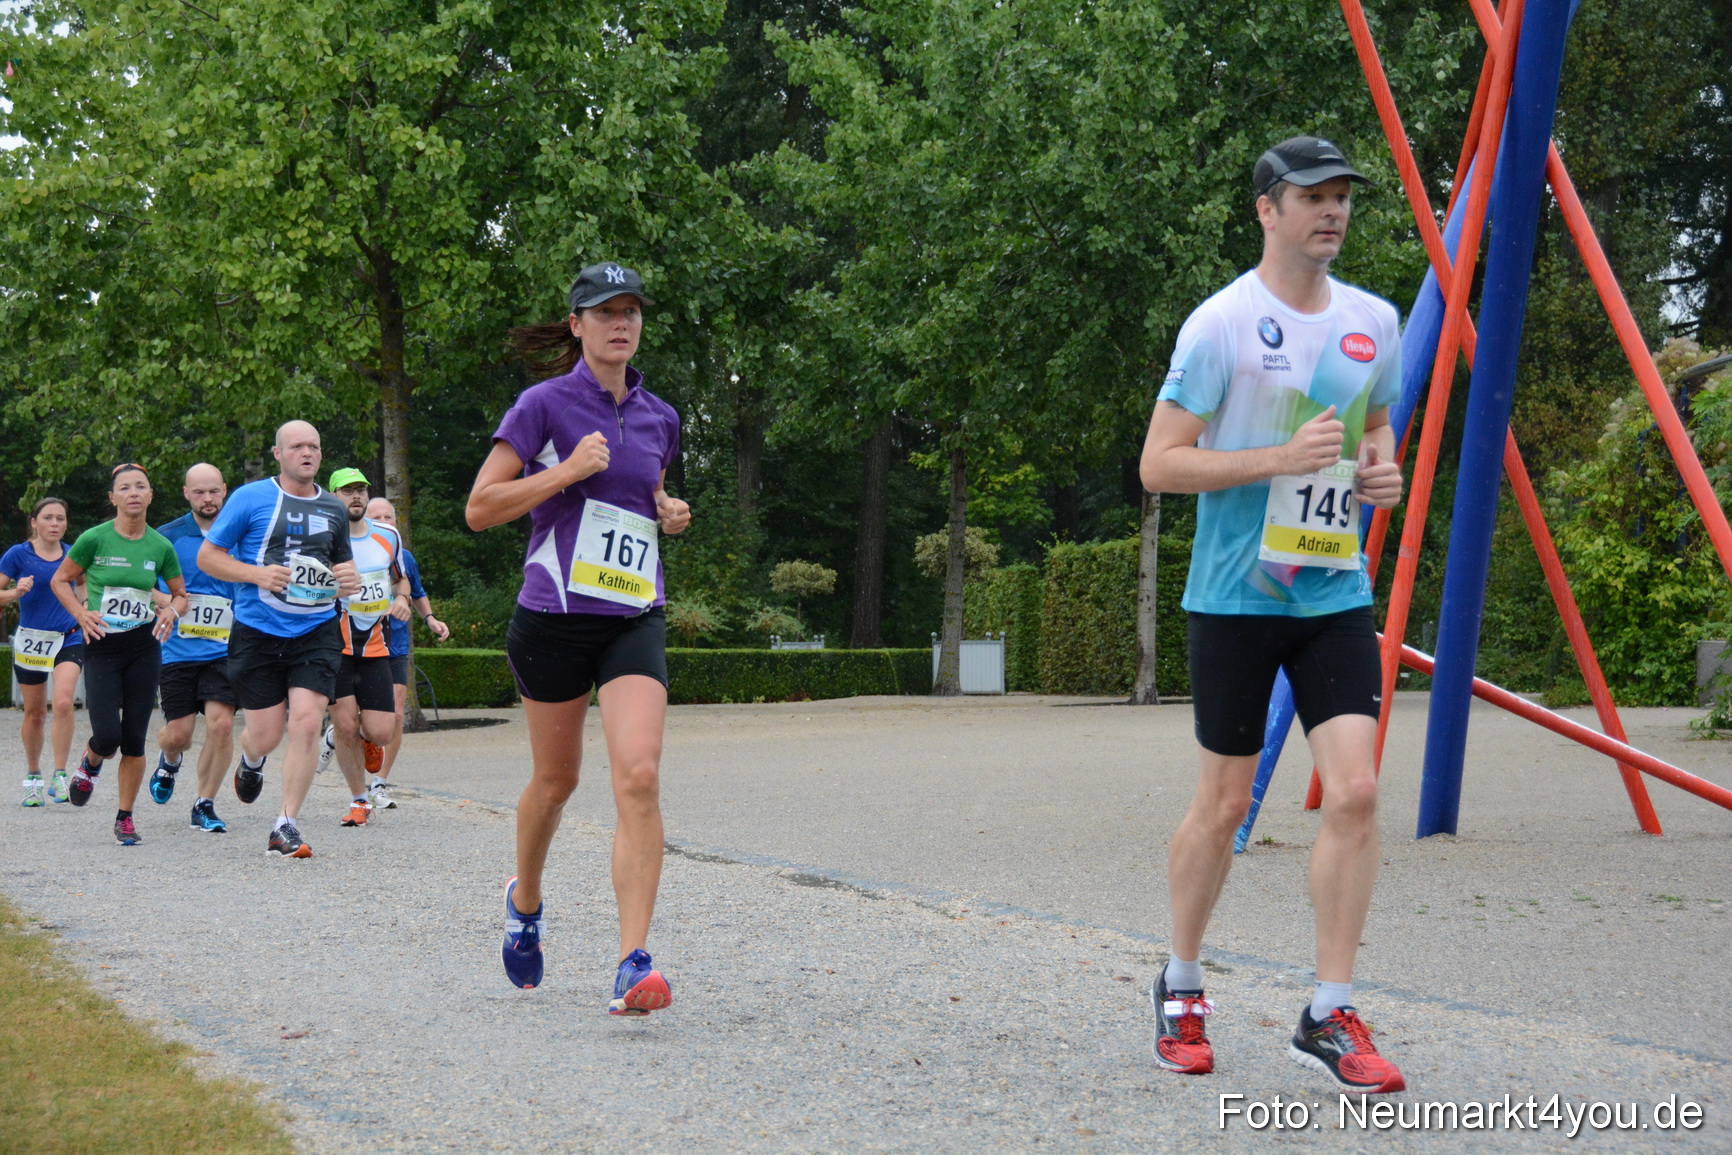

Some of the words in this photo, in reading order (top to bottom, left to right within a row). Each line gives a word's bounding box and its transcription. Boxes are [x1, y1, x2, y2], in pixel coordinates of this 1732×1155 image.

[1262, 354, 1291, 365] PAFTL
[1263, 363, 1292, 372] Neumarkt
[1296, 484, 1352, 528] 149
[601, 529, 649, 571] 167
[1296, 535, 1340, 554] Adrian
[296, 566, 337, 587] 2042
[598, 571, 641, 594] Kathrin
[360, 582, 384, 601] 215
[192, 606, 224, 625] 197
[190, 627, 219, 637] Andreas
[23, 638, 54, 656] 247
[24, 656, 48, 666] Yvonne
